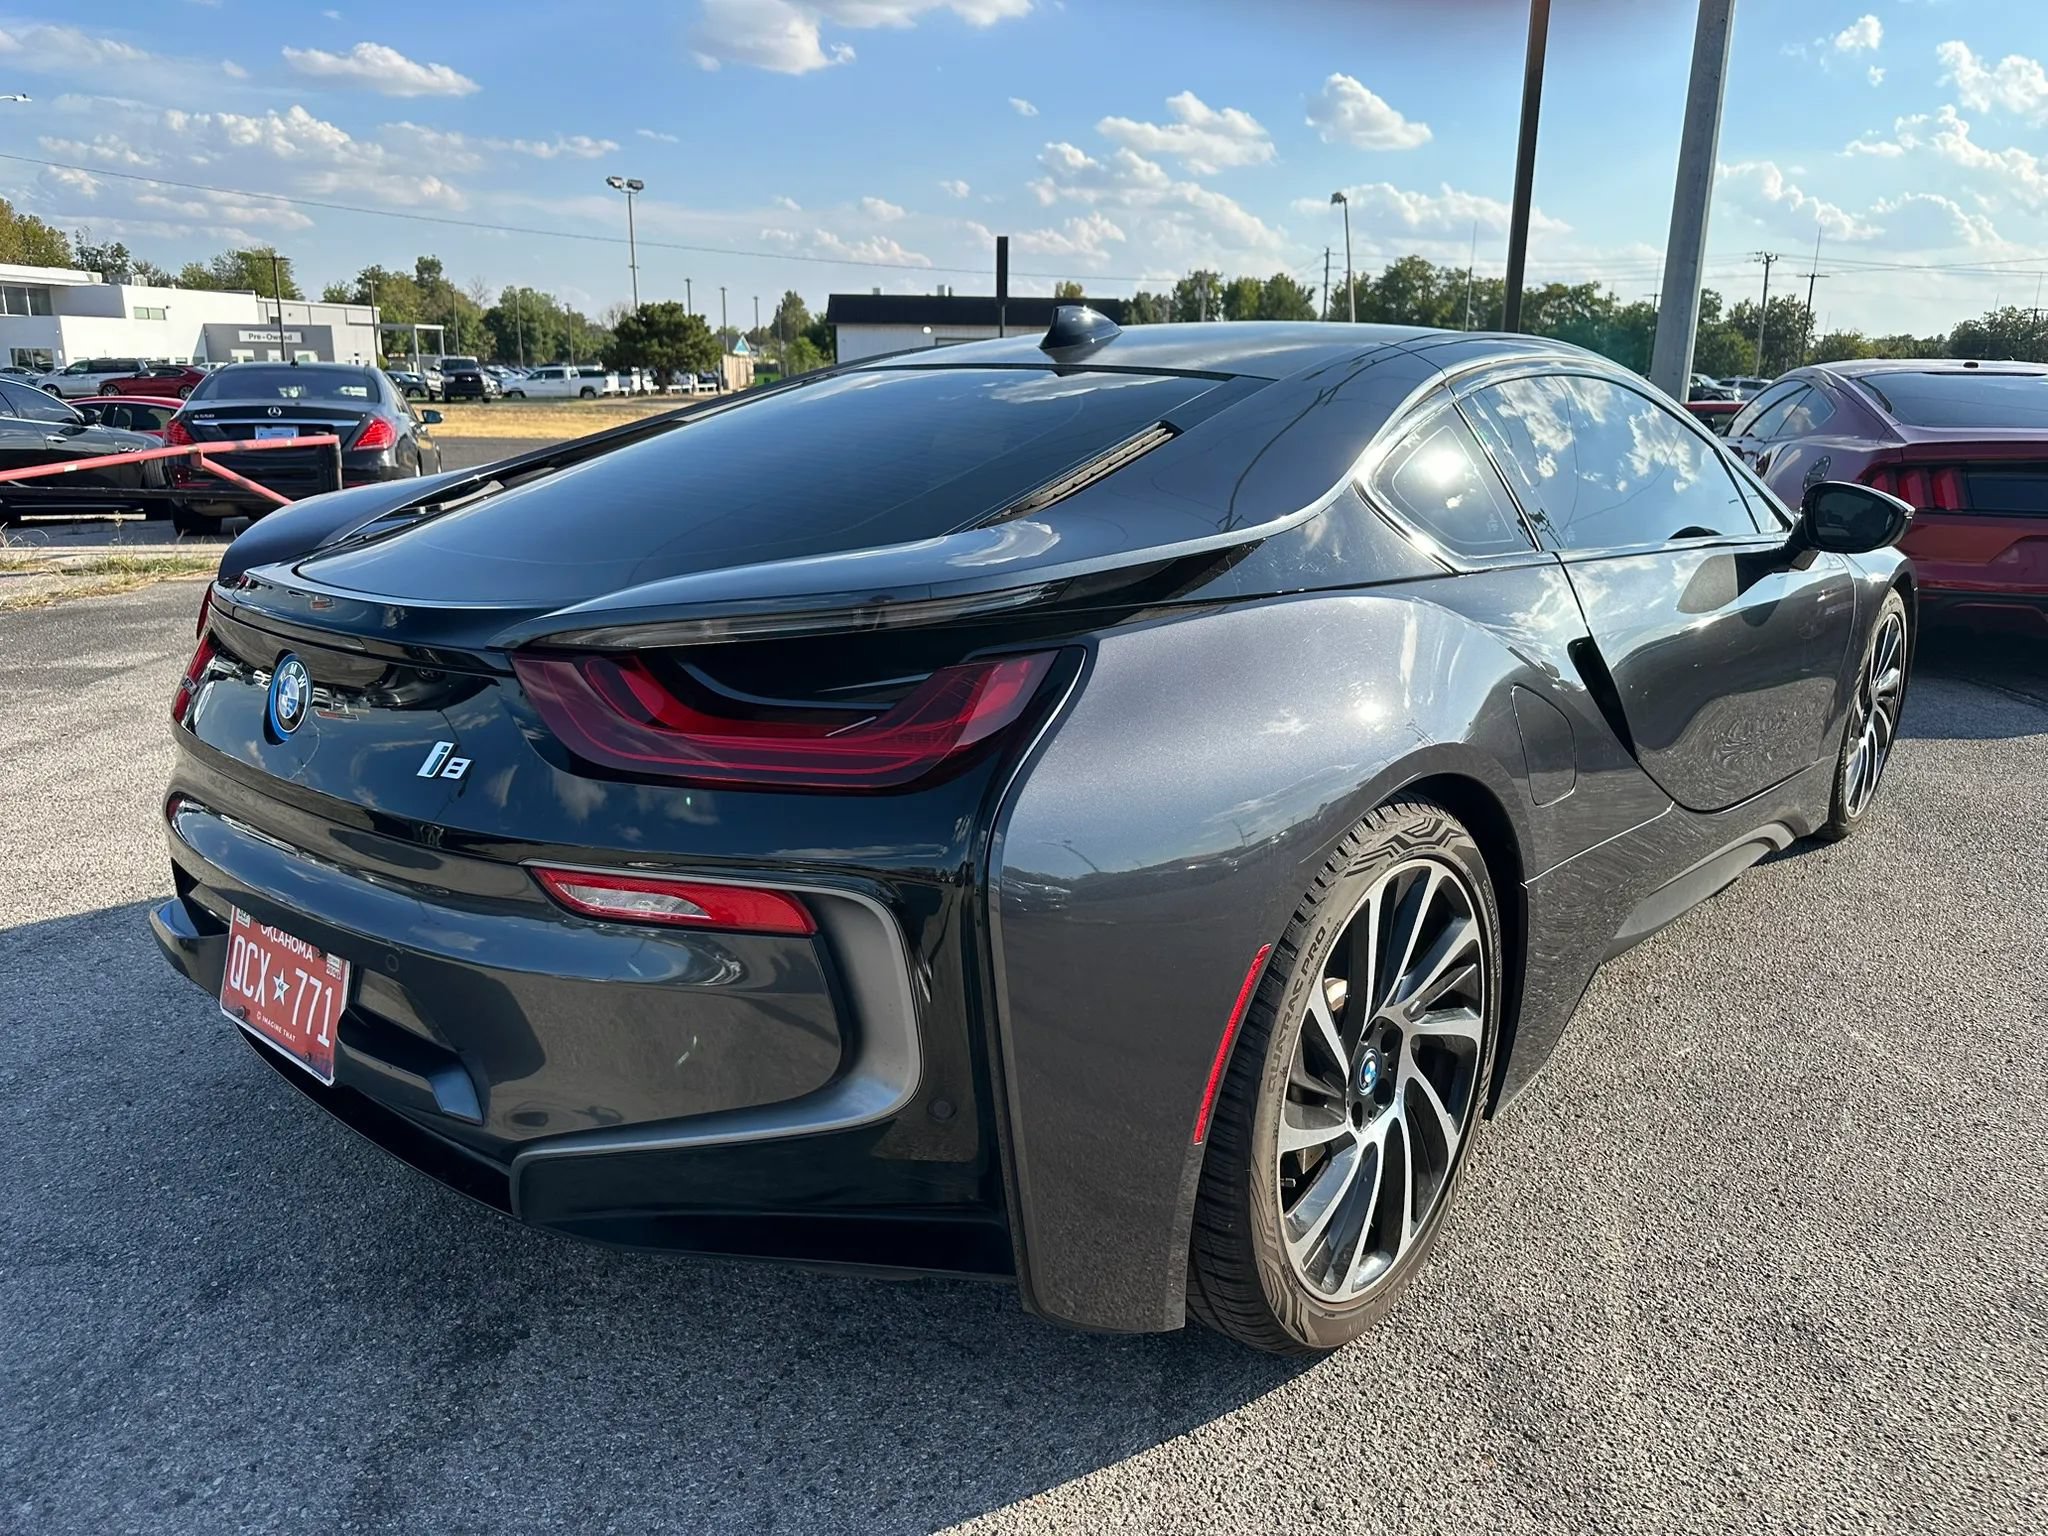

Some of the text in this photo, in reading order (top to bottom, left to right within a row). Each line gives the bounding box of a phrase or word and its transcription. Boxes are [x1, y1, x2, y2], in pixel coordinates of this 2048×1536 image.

[416, 741, 472, 780] i8
[261, 925, 313, 962] OKLAHOMA
[230, 935, 332, 1048] QCX 771
[1266, 978, 1304, 1093] QUATRAC
